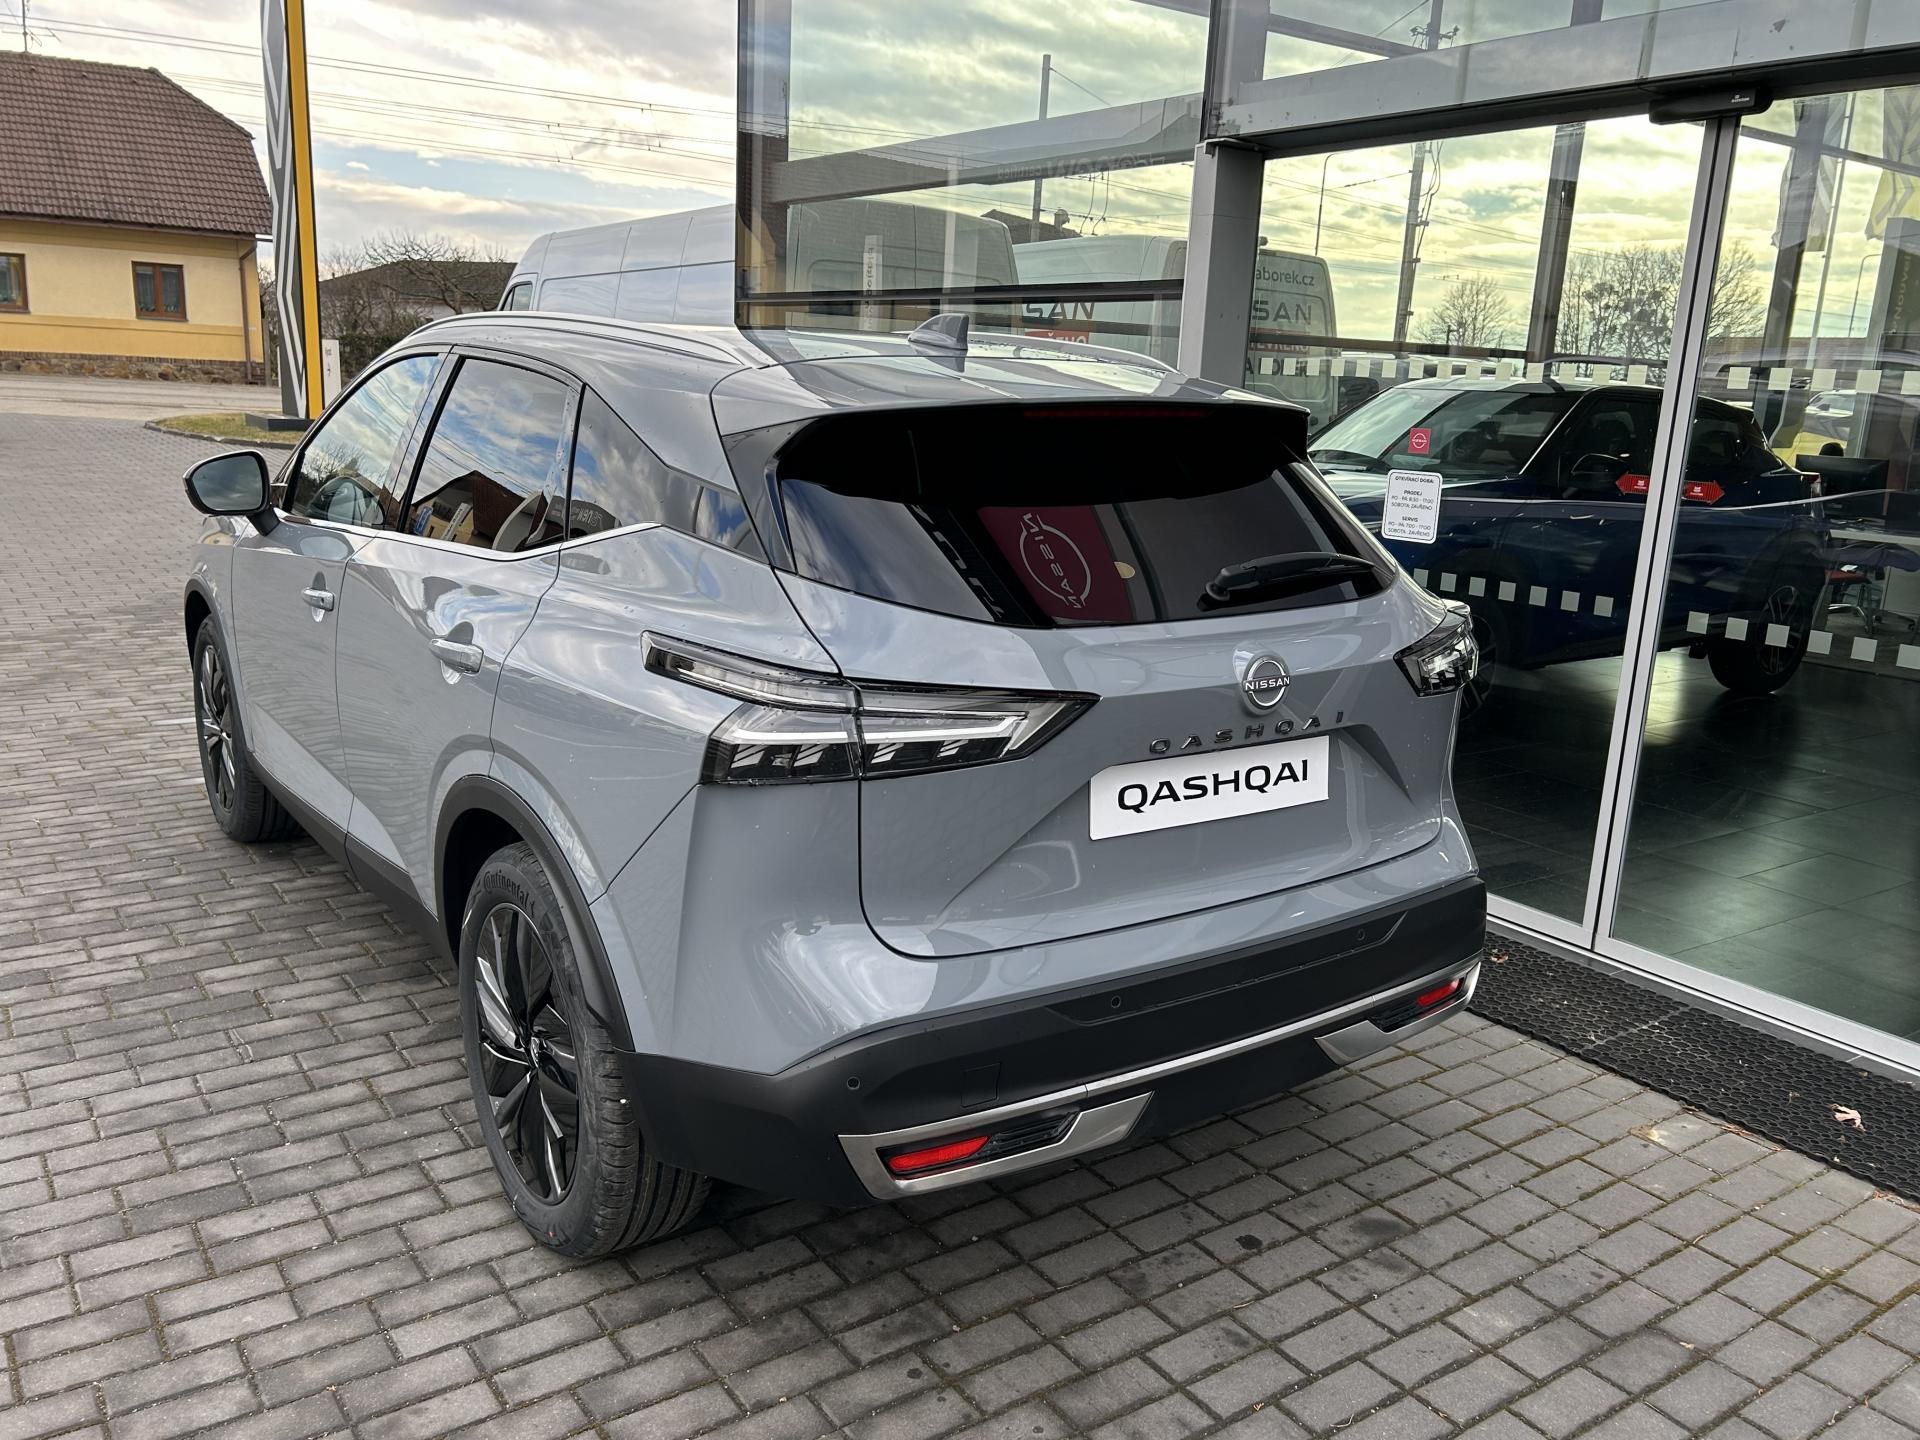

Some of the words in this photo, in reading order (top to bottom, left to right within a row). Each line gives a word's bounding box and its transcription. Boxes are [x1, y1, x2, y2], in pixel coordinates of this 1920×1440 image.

[1244, 676, 1290, 691] NISSAN
[1150, 711, 1344, 754] QASHQAI
[1117, 759, 1308, 813] QASHQAI
[483, 869, 530, 907] Continental
